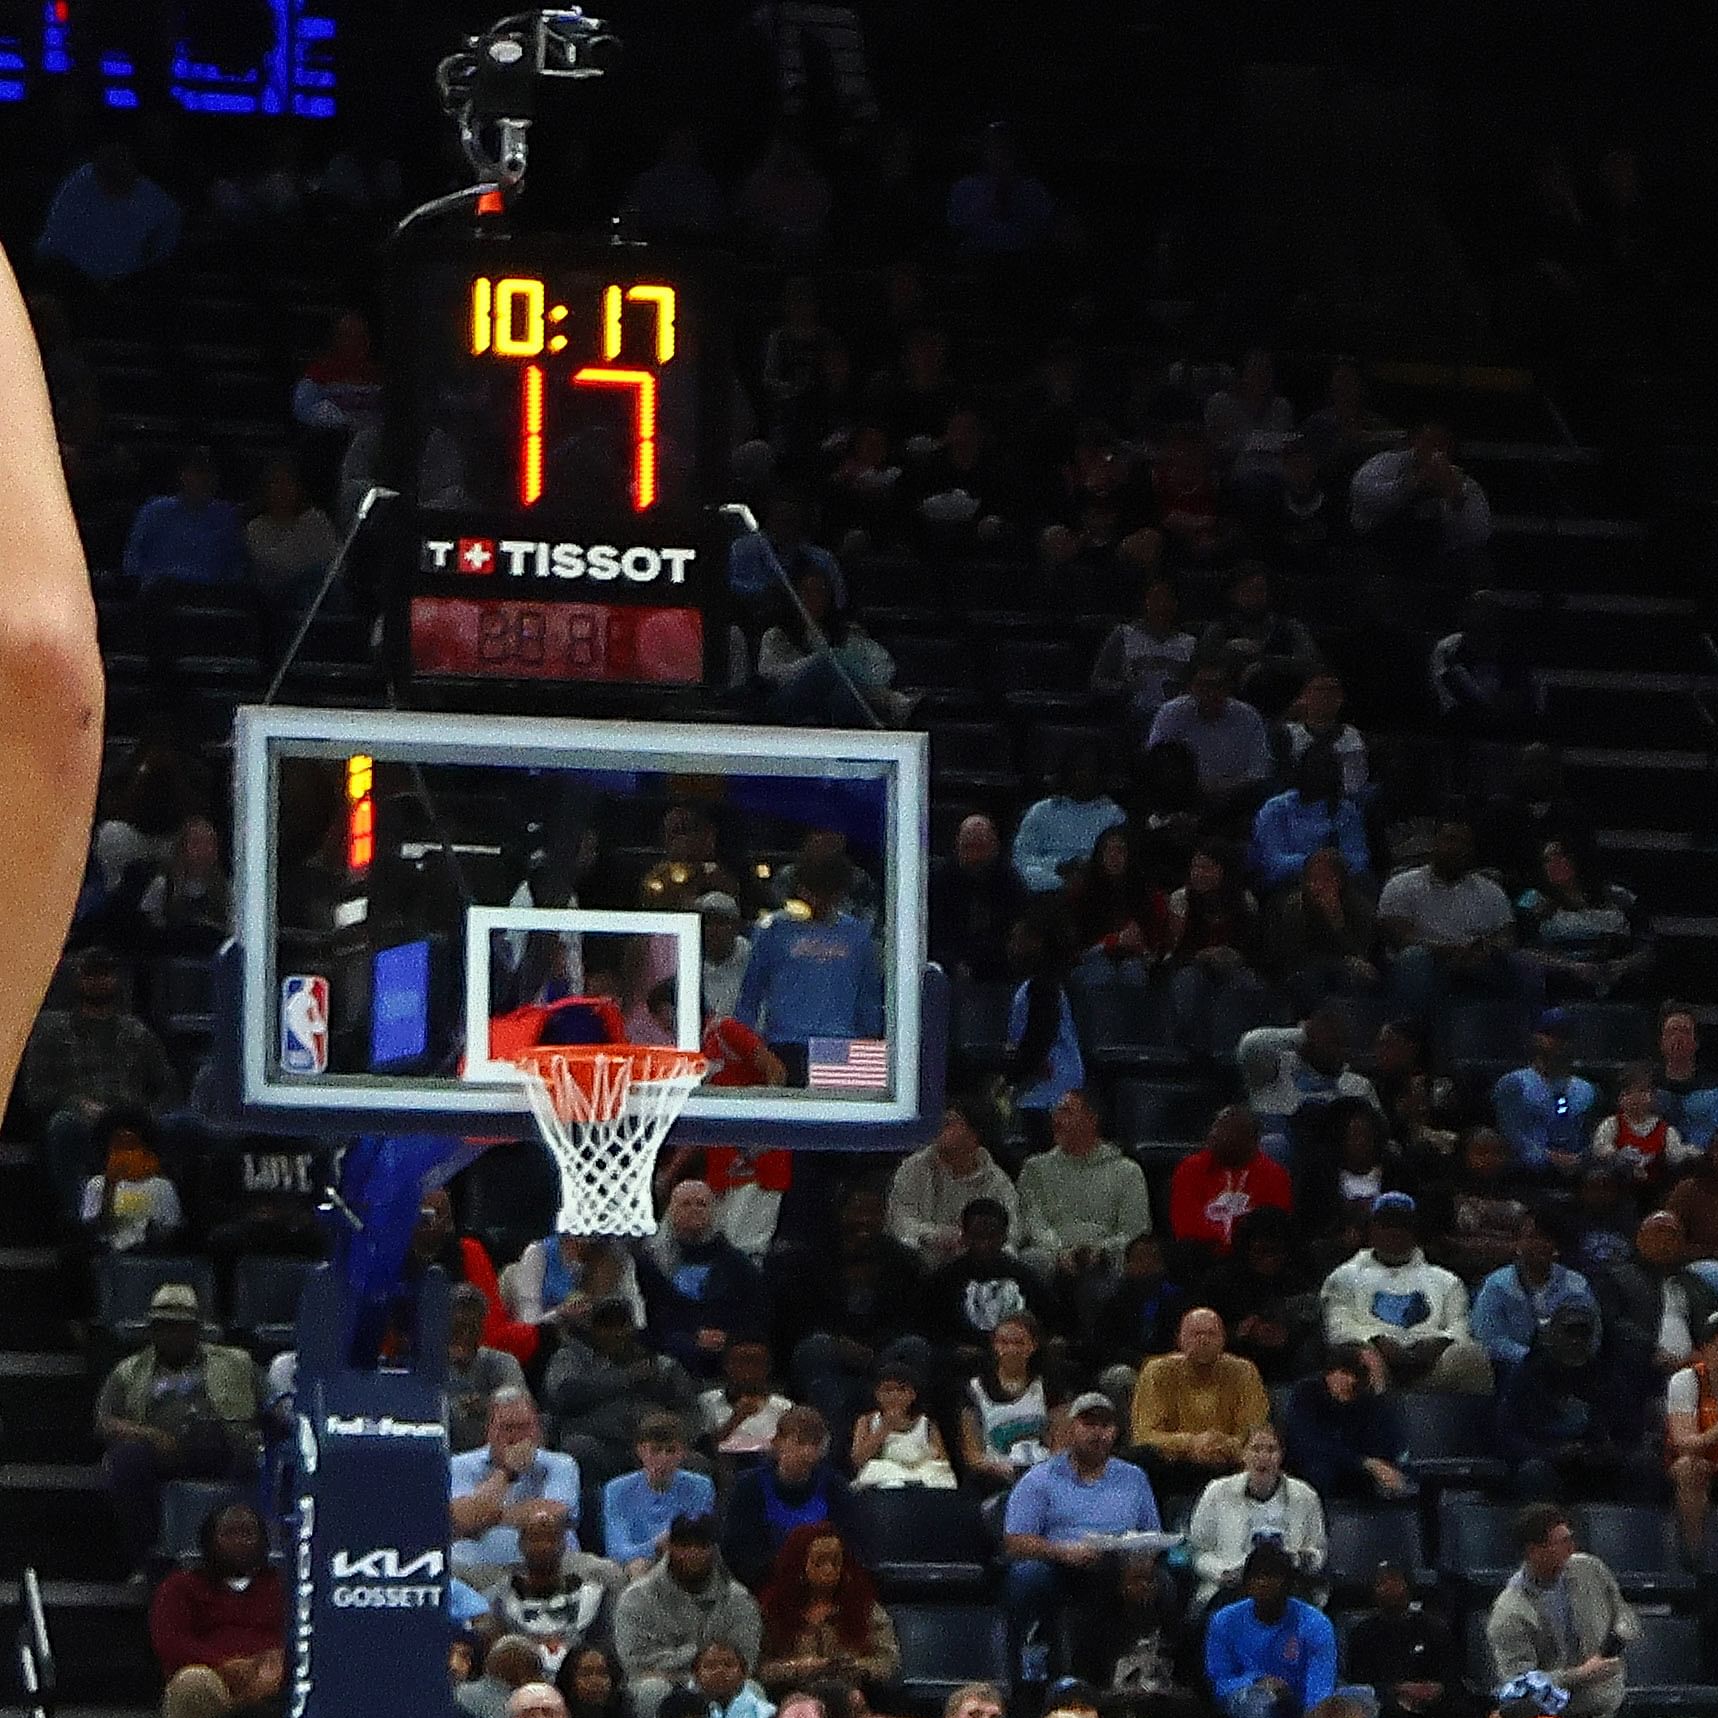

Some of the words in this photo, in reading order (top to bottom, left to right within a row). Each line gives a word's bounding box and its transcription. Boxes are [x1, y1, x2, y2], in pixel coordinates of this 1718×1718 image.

[472, 276, 676, 366] 10:17
[523, 364, 656, 512] 17
[500, 542, 696, 584] TISSOT
[332, 1550, 444, 1578] KIA
[333, 1586, 443, 1608] GOSSETT
